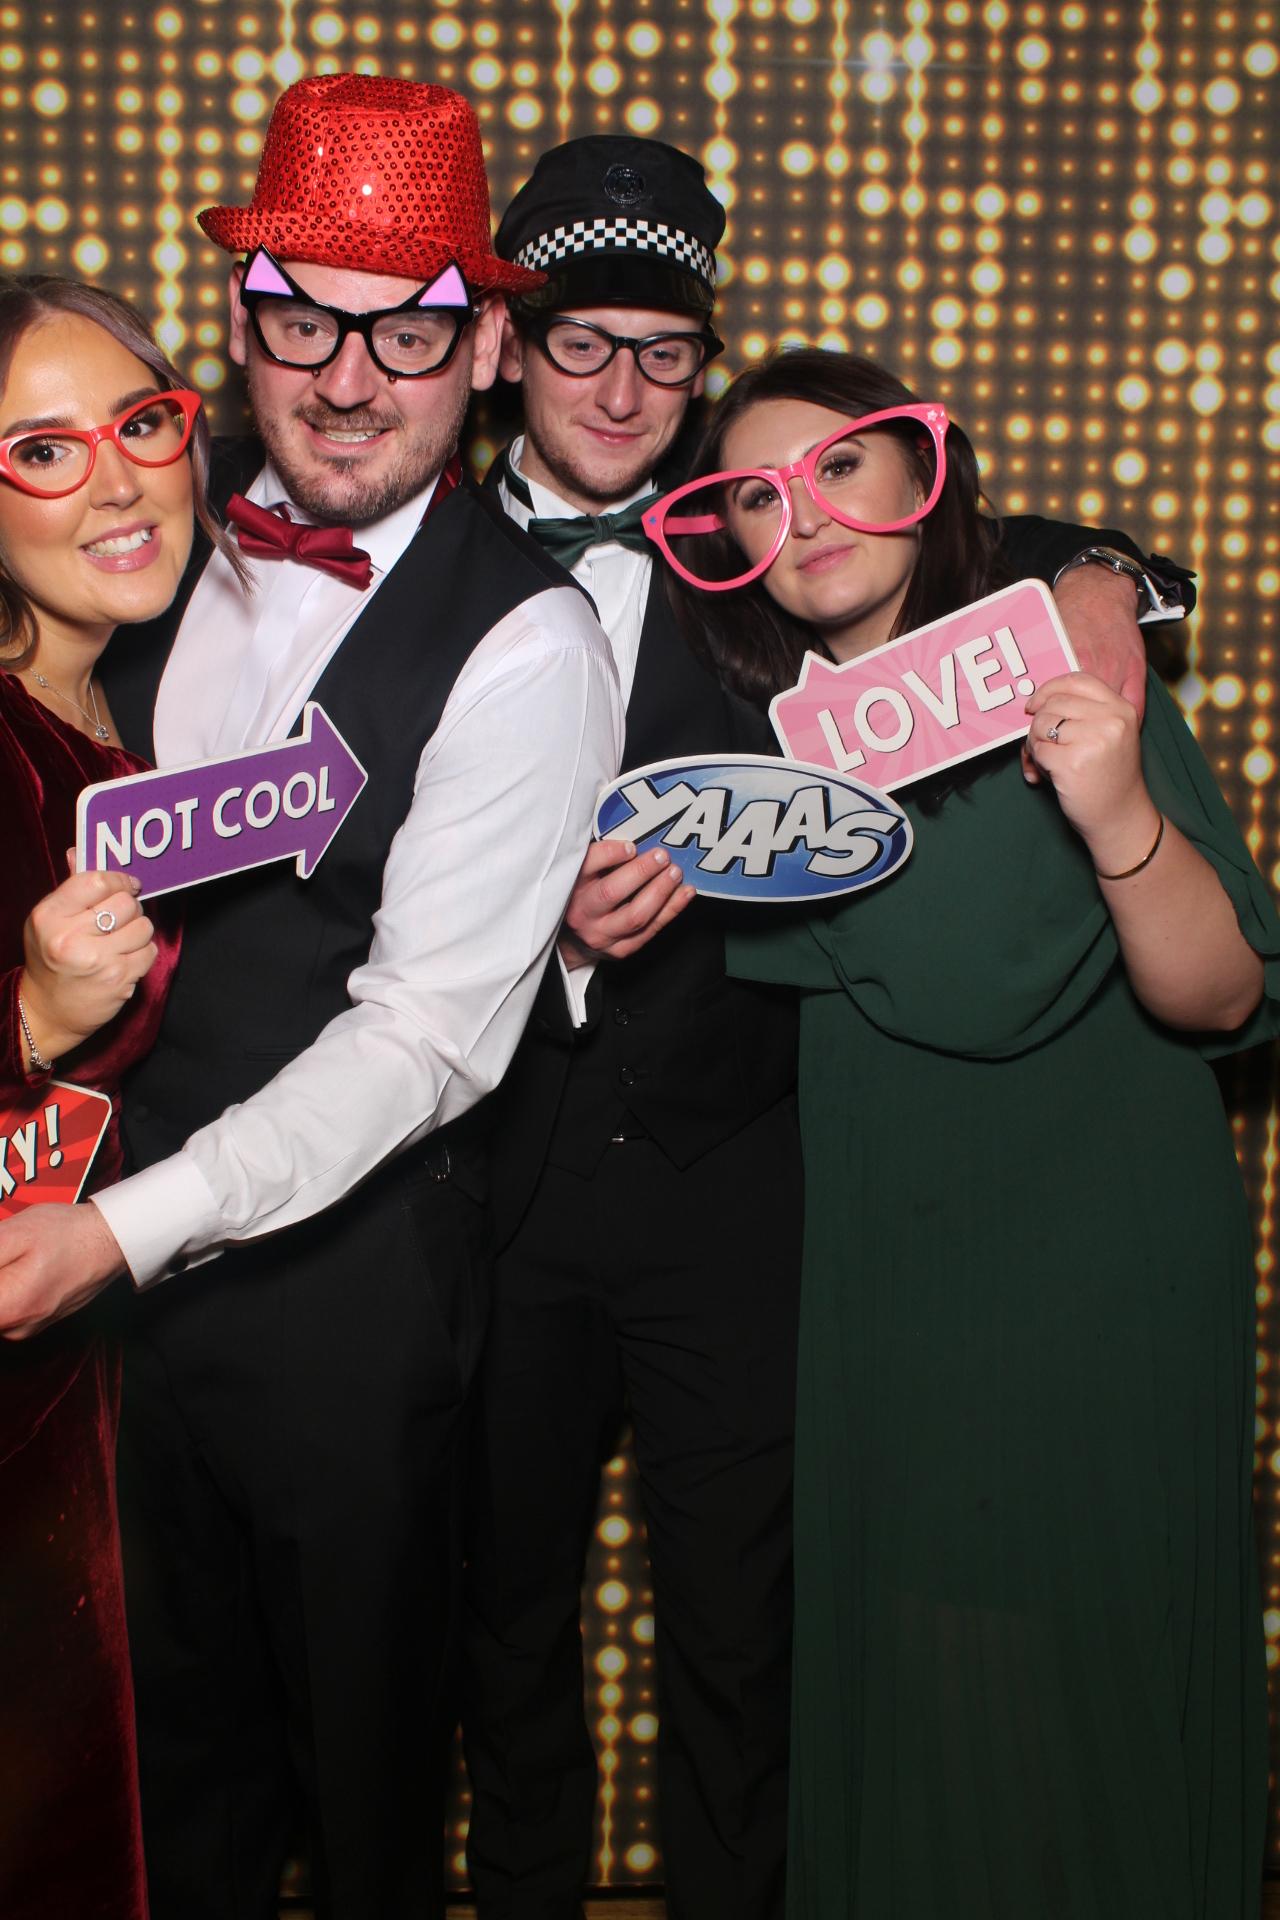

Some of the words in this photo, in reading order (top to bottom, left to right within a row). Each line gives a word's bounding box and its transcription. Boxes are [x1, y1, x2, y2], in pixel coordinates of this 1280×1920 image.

[817, 626, 1036, 773] LOVE!
[96, 797, 199, 871] NOT
[212, 766, 336, 838] COOL
[600, 777, 905, 878] YAAAS
